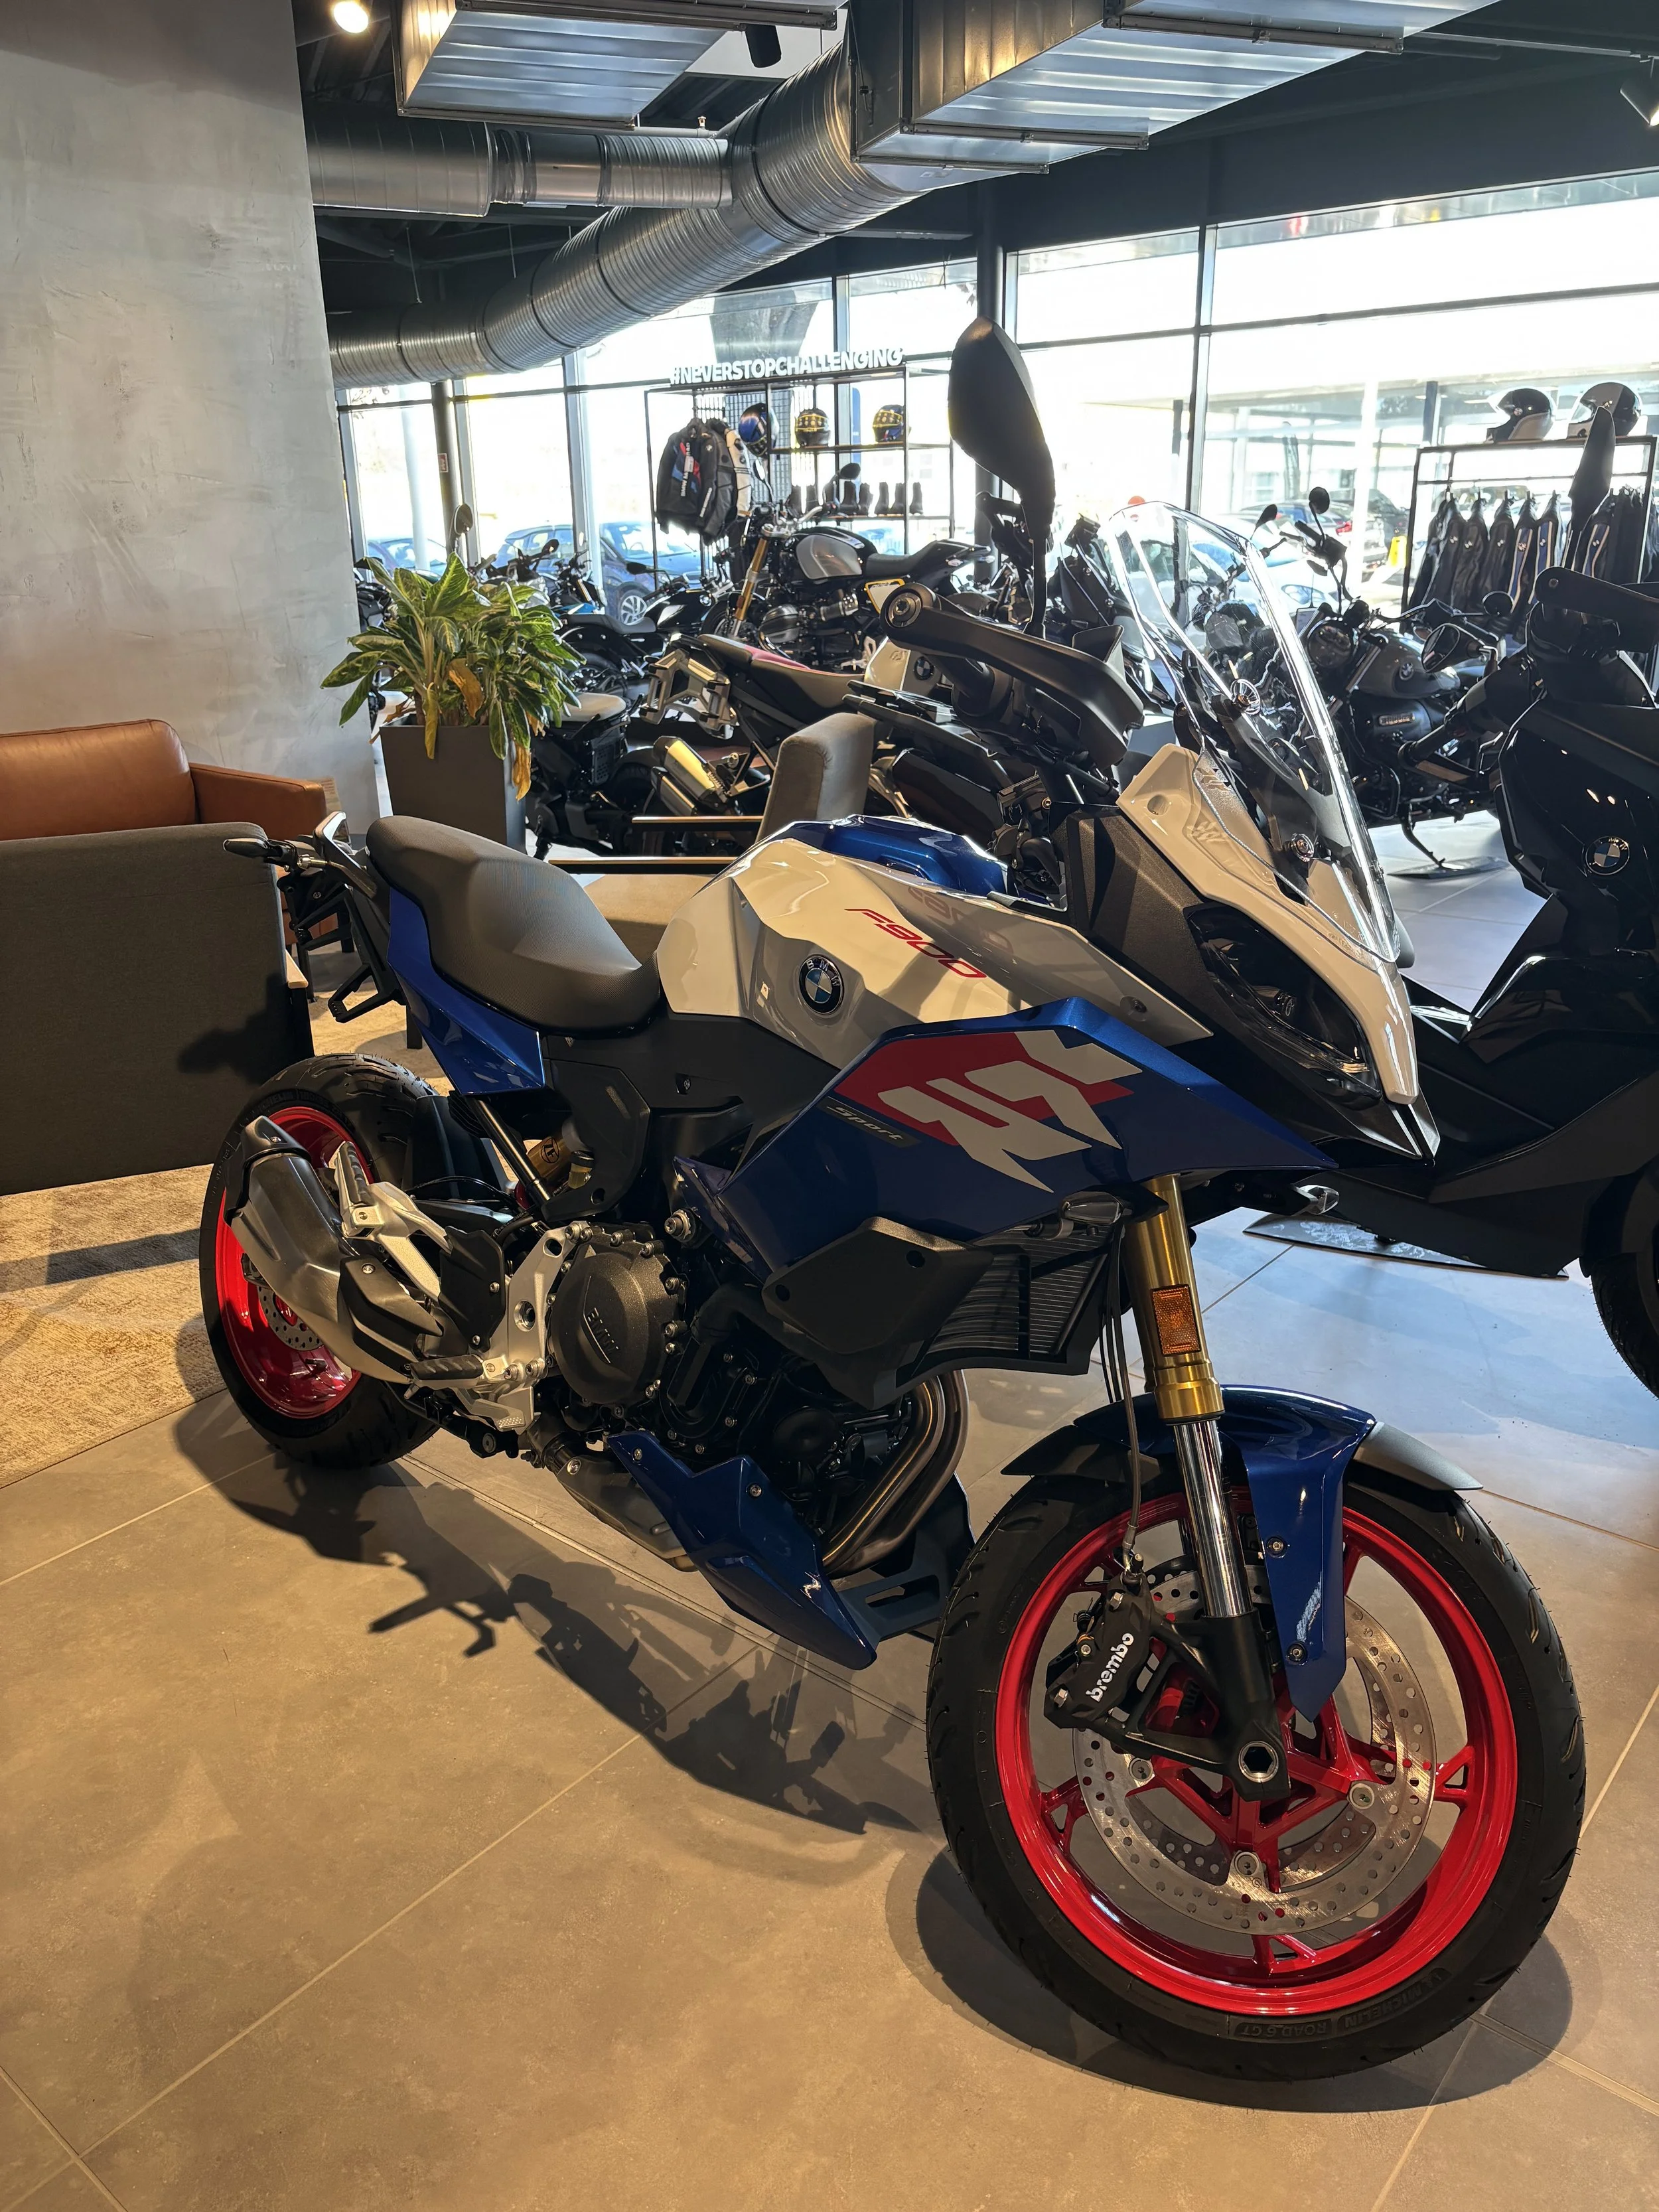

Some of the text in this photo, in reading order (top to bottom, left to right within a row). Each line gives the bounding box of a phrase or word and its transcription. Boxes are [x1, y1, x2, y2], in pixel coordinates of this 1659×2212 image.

[670, 347, 904, 385] #NEVERSTOPCHALLENGING
[806, 959, 840, 987] BMW
[826, 1105, 904, 1143] Sport
[1086, 1633, 1134, 1702] brembo
[1282, 2021, 1327, 2037] ROAD
